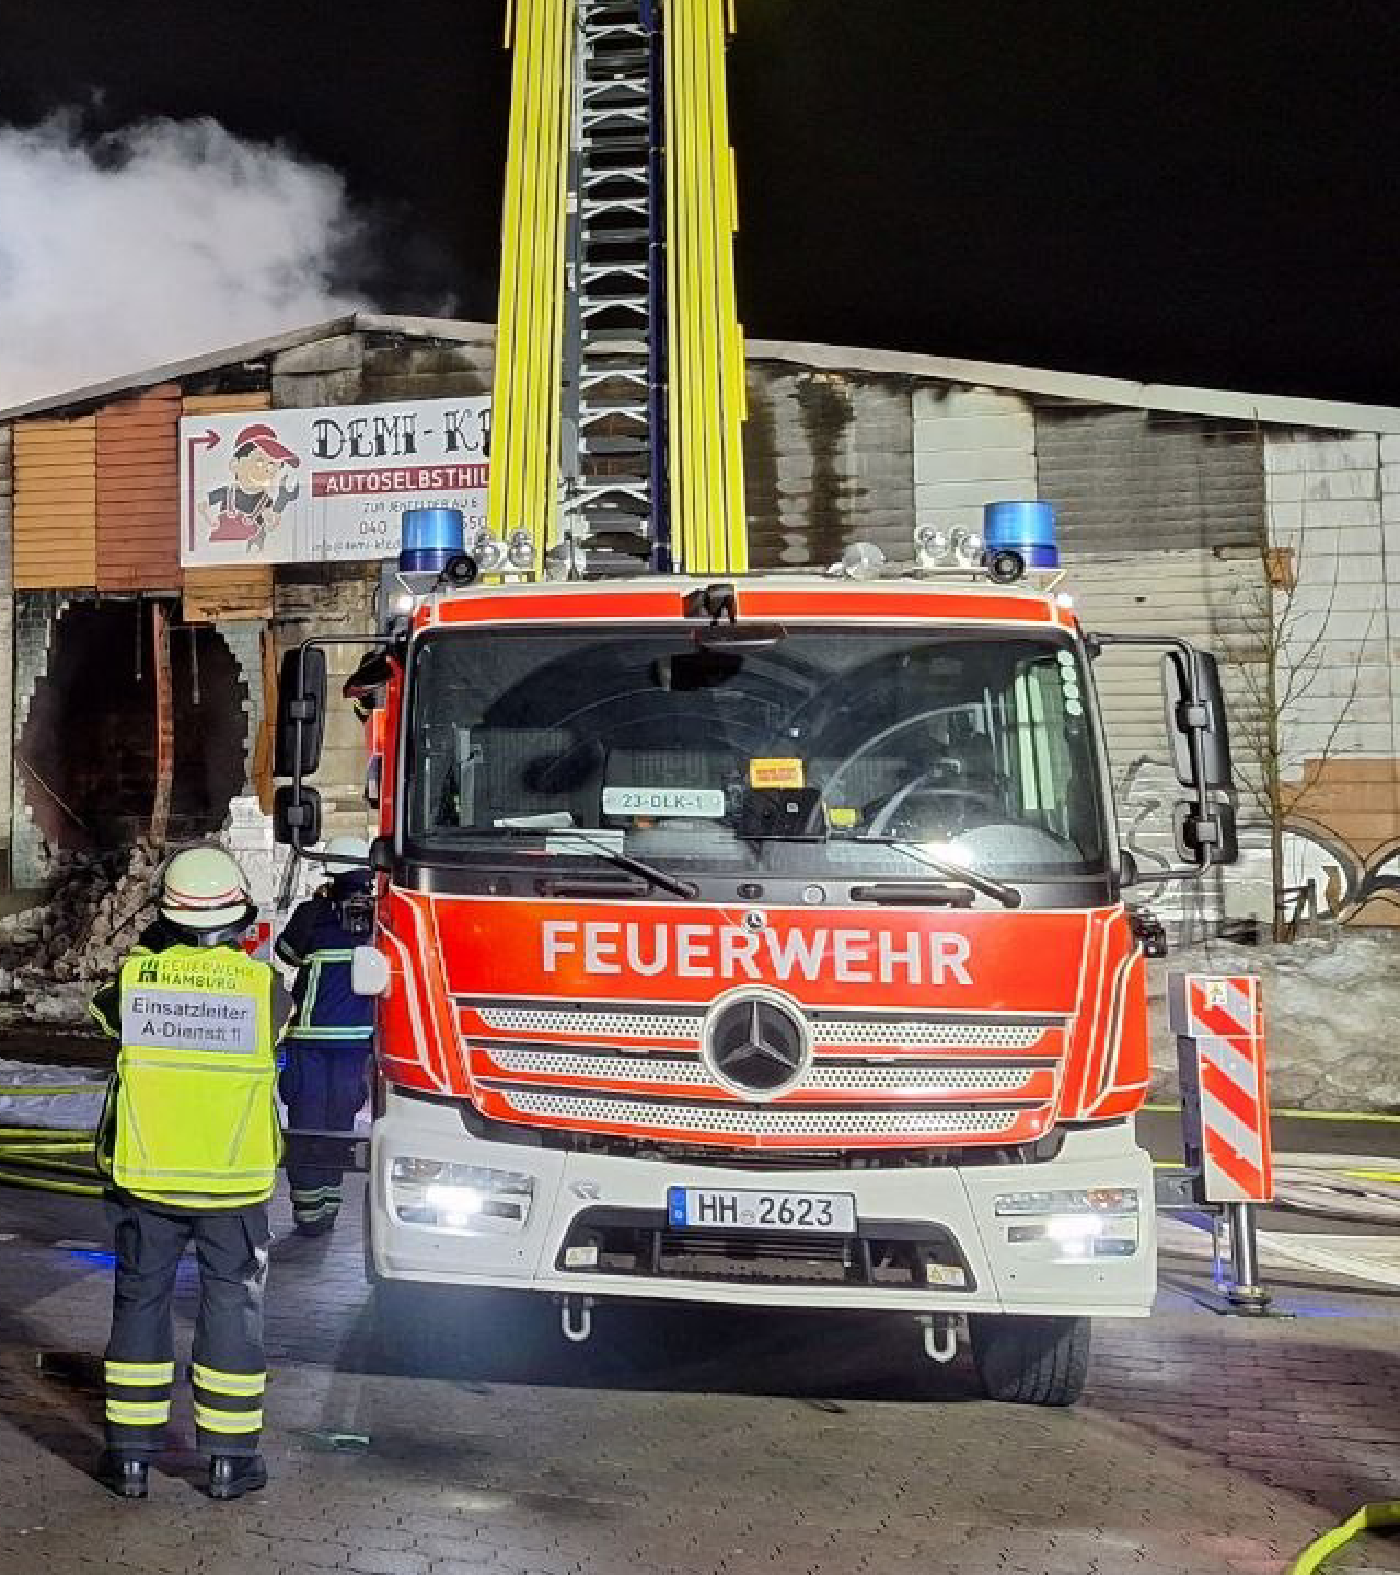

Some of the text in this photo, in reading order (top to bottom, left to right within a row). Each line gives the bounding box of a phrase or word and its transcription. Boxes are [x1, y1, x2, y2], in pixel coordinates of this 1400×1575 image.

[327, 467, 490, 493] AUTOSELBSTHIL
[359, 520, 387, 535] 040
[541, 919, 975, 986] FEUERWEHR
[160, 971, 237, 991] HAMBURG
[131, 997, 248, 1021] Einsatzleiter
[698, 1192, 739, 1223] HH
[758, 1197, 834, 1226] 2623
